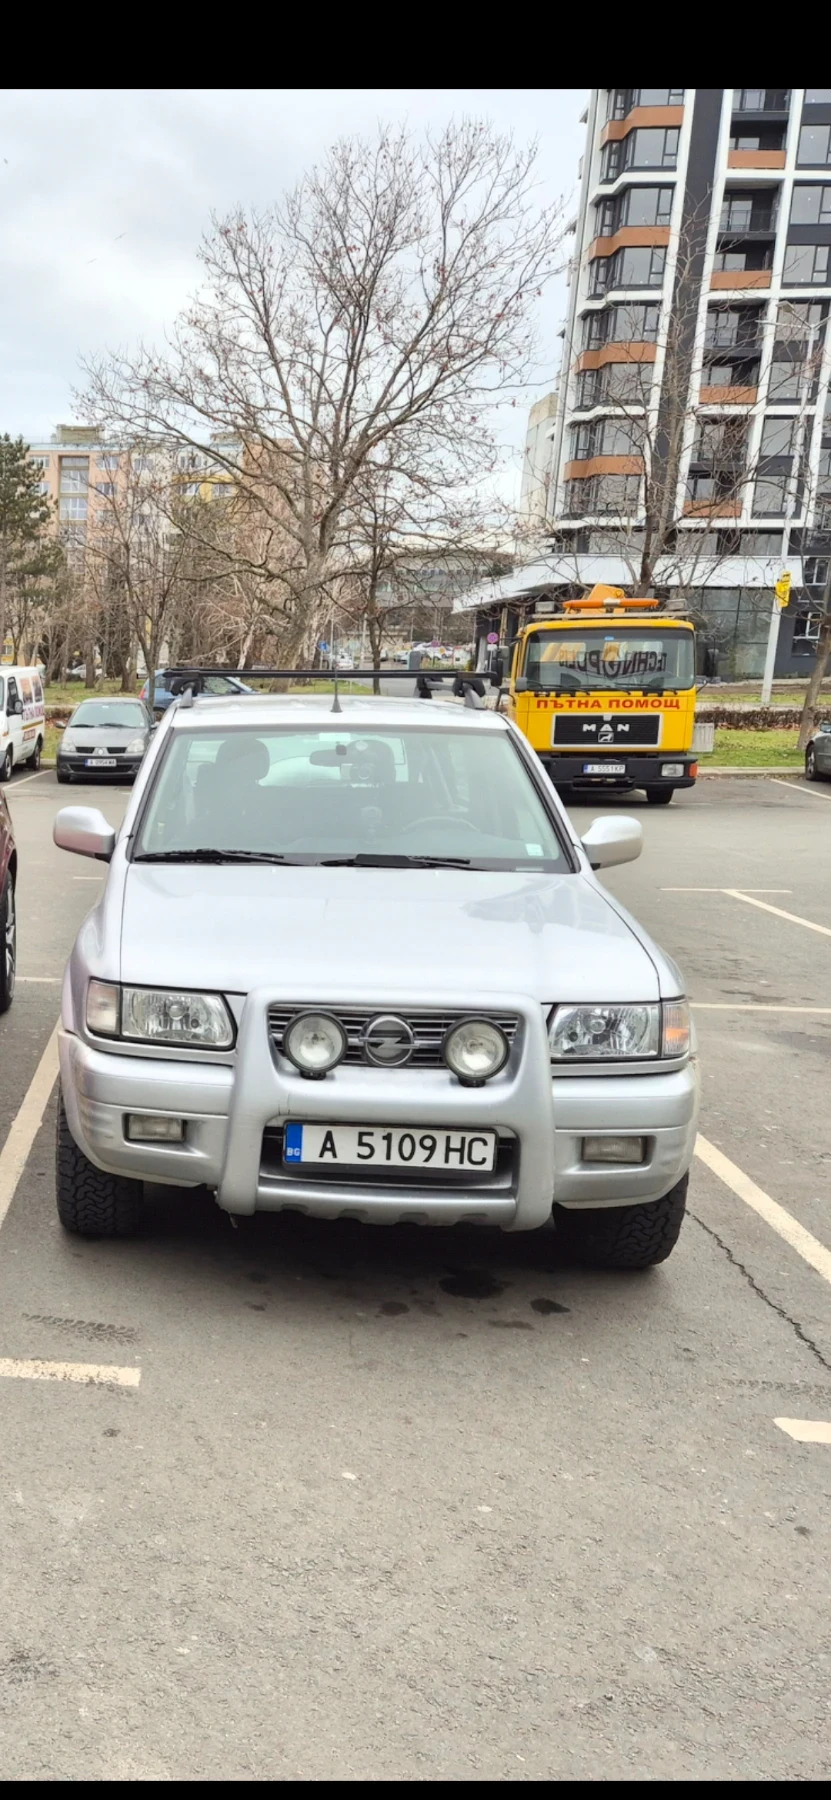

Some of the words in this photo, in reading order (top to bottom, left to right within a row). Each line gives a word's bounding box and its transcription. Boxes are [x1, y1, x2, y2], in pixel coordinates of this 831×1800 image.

[536, 699, 602, 709] ПЪТНА
[608, 699, 681, 710] ПОМОЩ
[582, 723, 630, 732] MAN
[318, 1130, 338, 1159] A
[286, 1147, 301, 1157] BG
